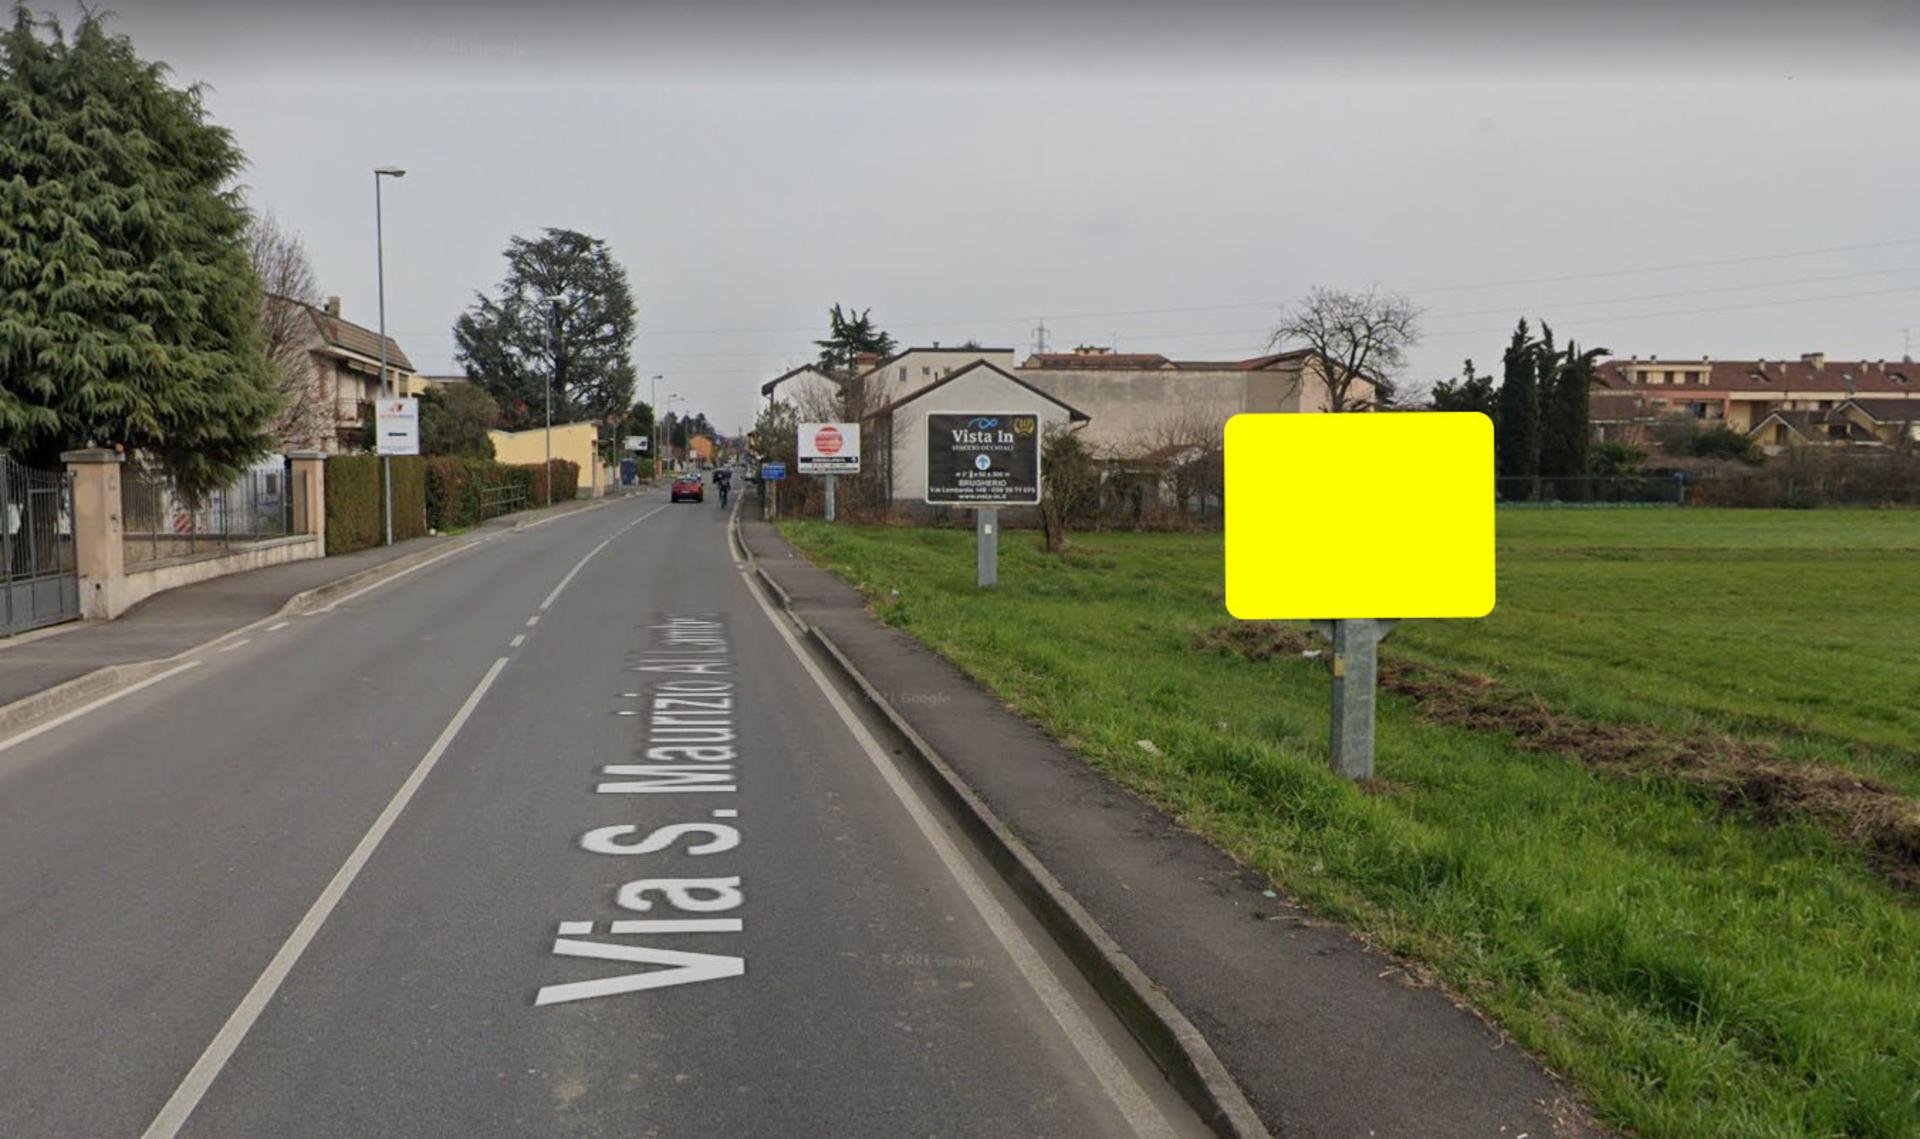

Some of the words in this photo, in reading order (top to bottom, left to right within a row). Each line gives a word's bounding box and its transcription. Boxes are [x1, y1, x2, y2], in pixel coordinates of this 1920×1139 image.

[952, 429, 993, 443] Vista
[997, 429, 1014, 443] In
[958, 479, 1007, 487] BRUGHERIO
